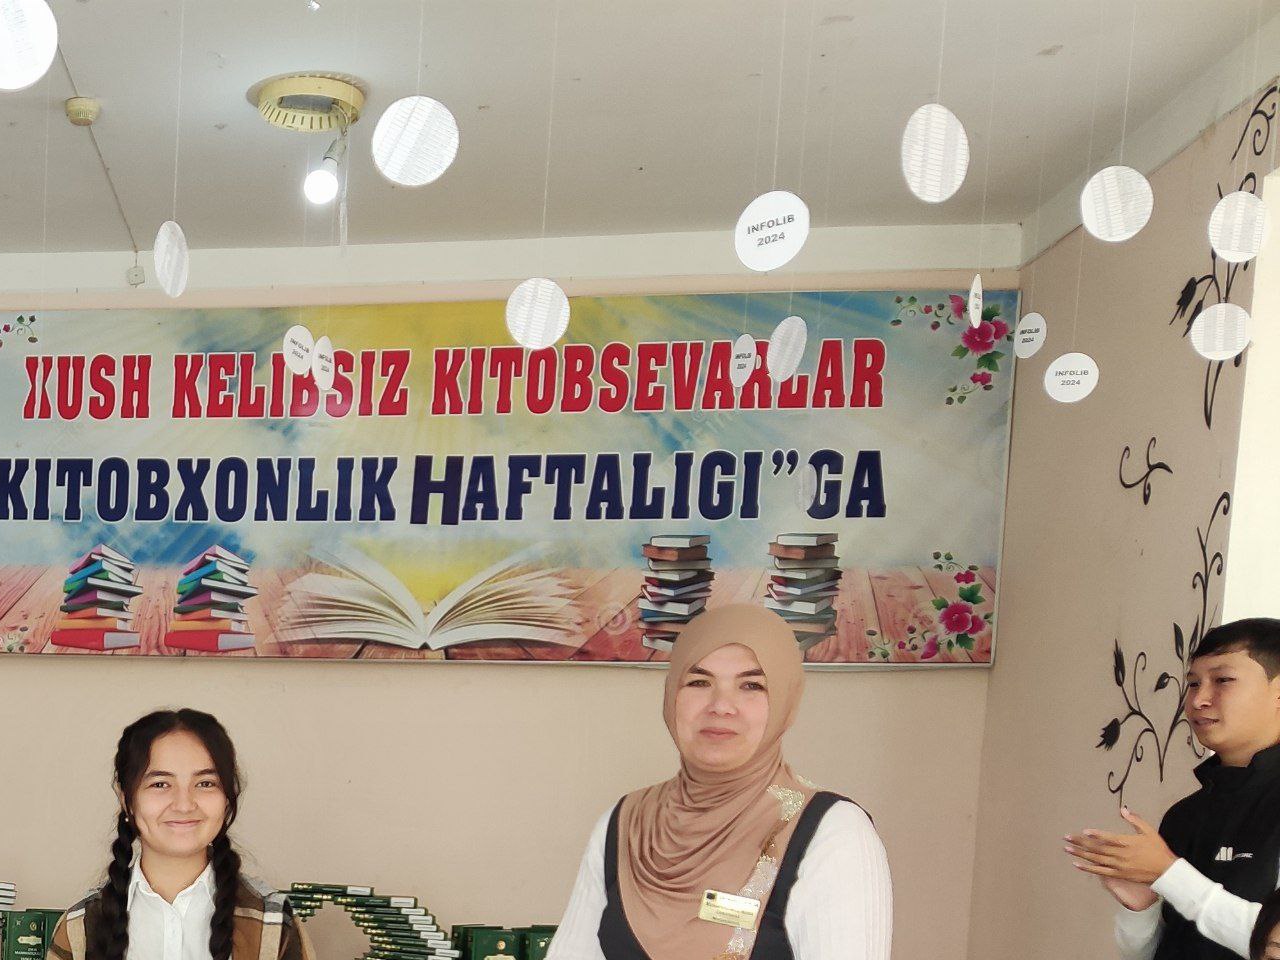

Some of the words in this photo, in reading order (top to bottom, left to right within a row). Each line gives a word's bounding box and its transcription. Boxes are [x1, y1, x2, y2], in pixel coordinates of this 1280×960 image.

[747, 214, 795, 235] INFOLIB
[757, 231, 786, 247] 2024
[1054, 369, 1089, 377] INFOLIB
[23, 354, 152, 420] XUSH
[172, 350, 411, 419] KELIBSIZ
